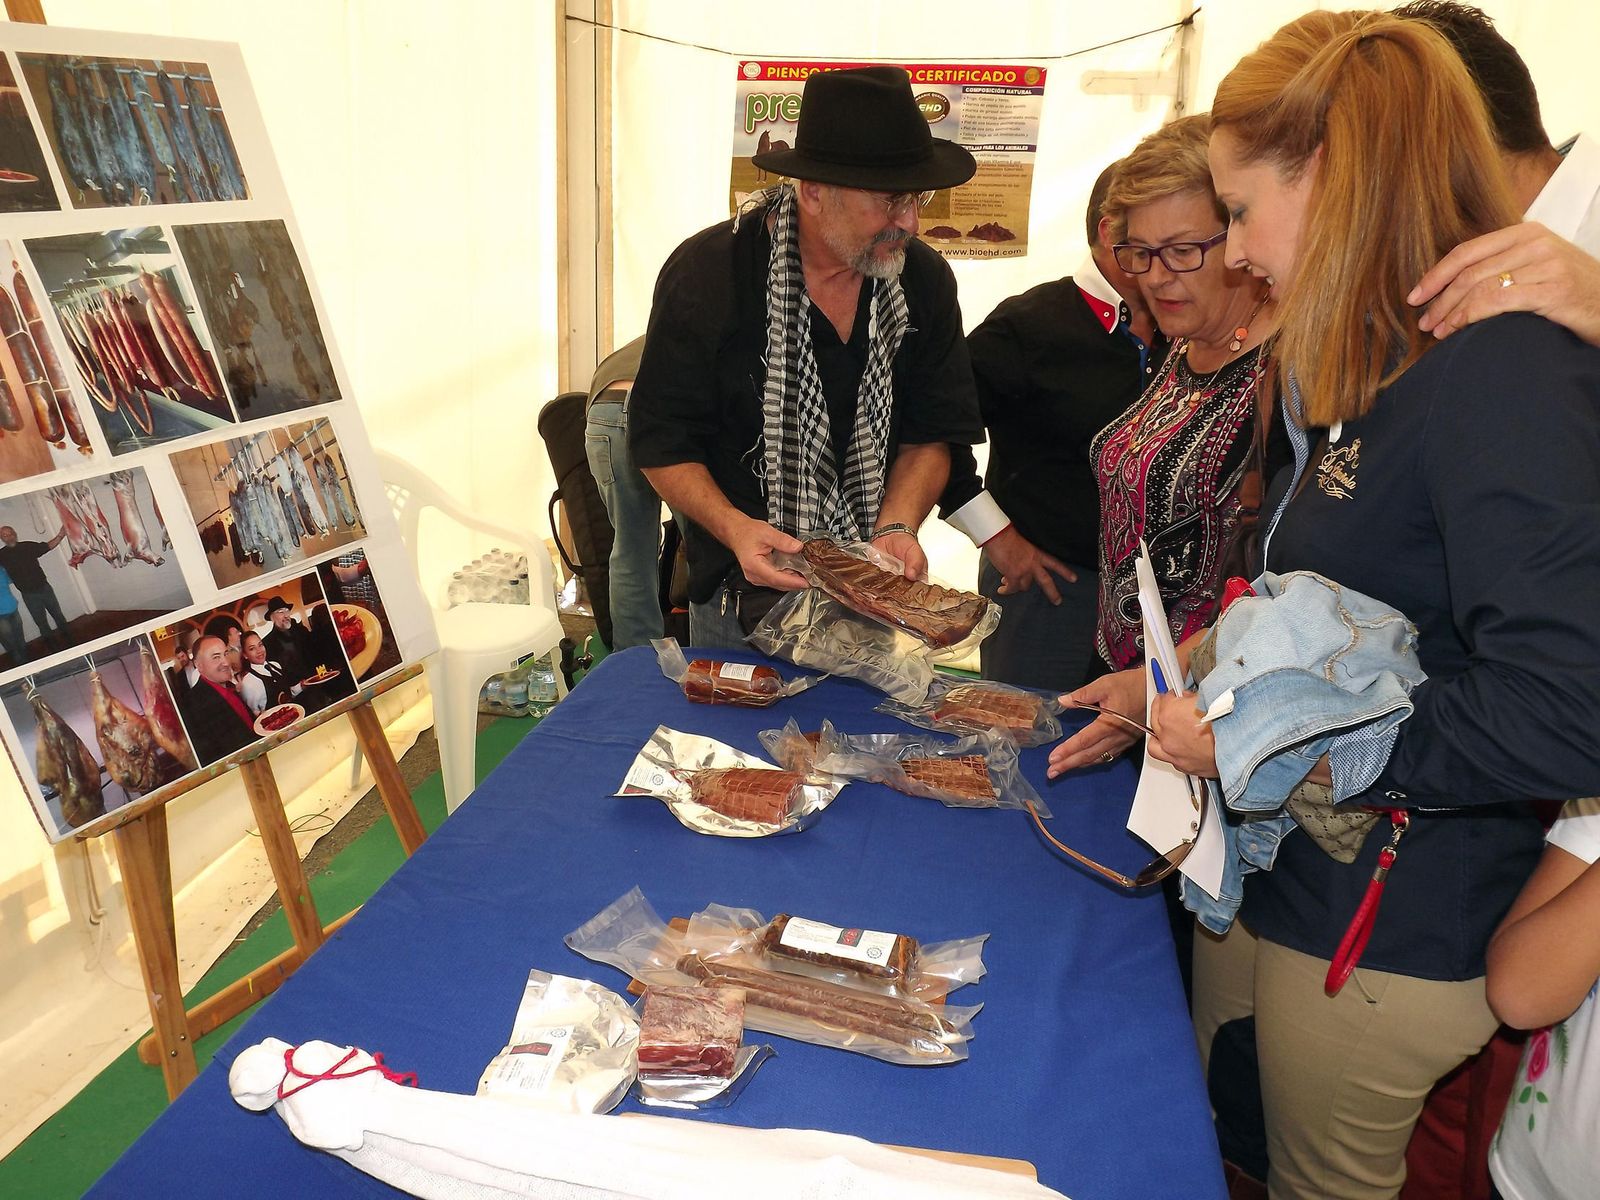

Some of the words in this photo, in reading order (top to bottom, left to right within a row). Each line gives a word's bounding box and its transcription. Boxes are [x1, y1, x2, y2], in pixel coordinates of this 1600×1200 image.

[916, 70, 1016, 83] CERTIFICADO
[918, 104, 942, 112] EHD
[944, 248, 1022, 257] www.bioehd.com
